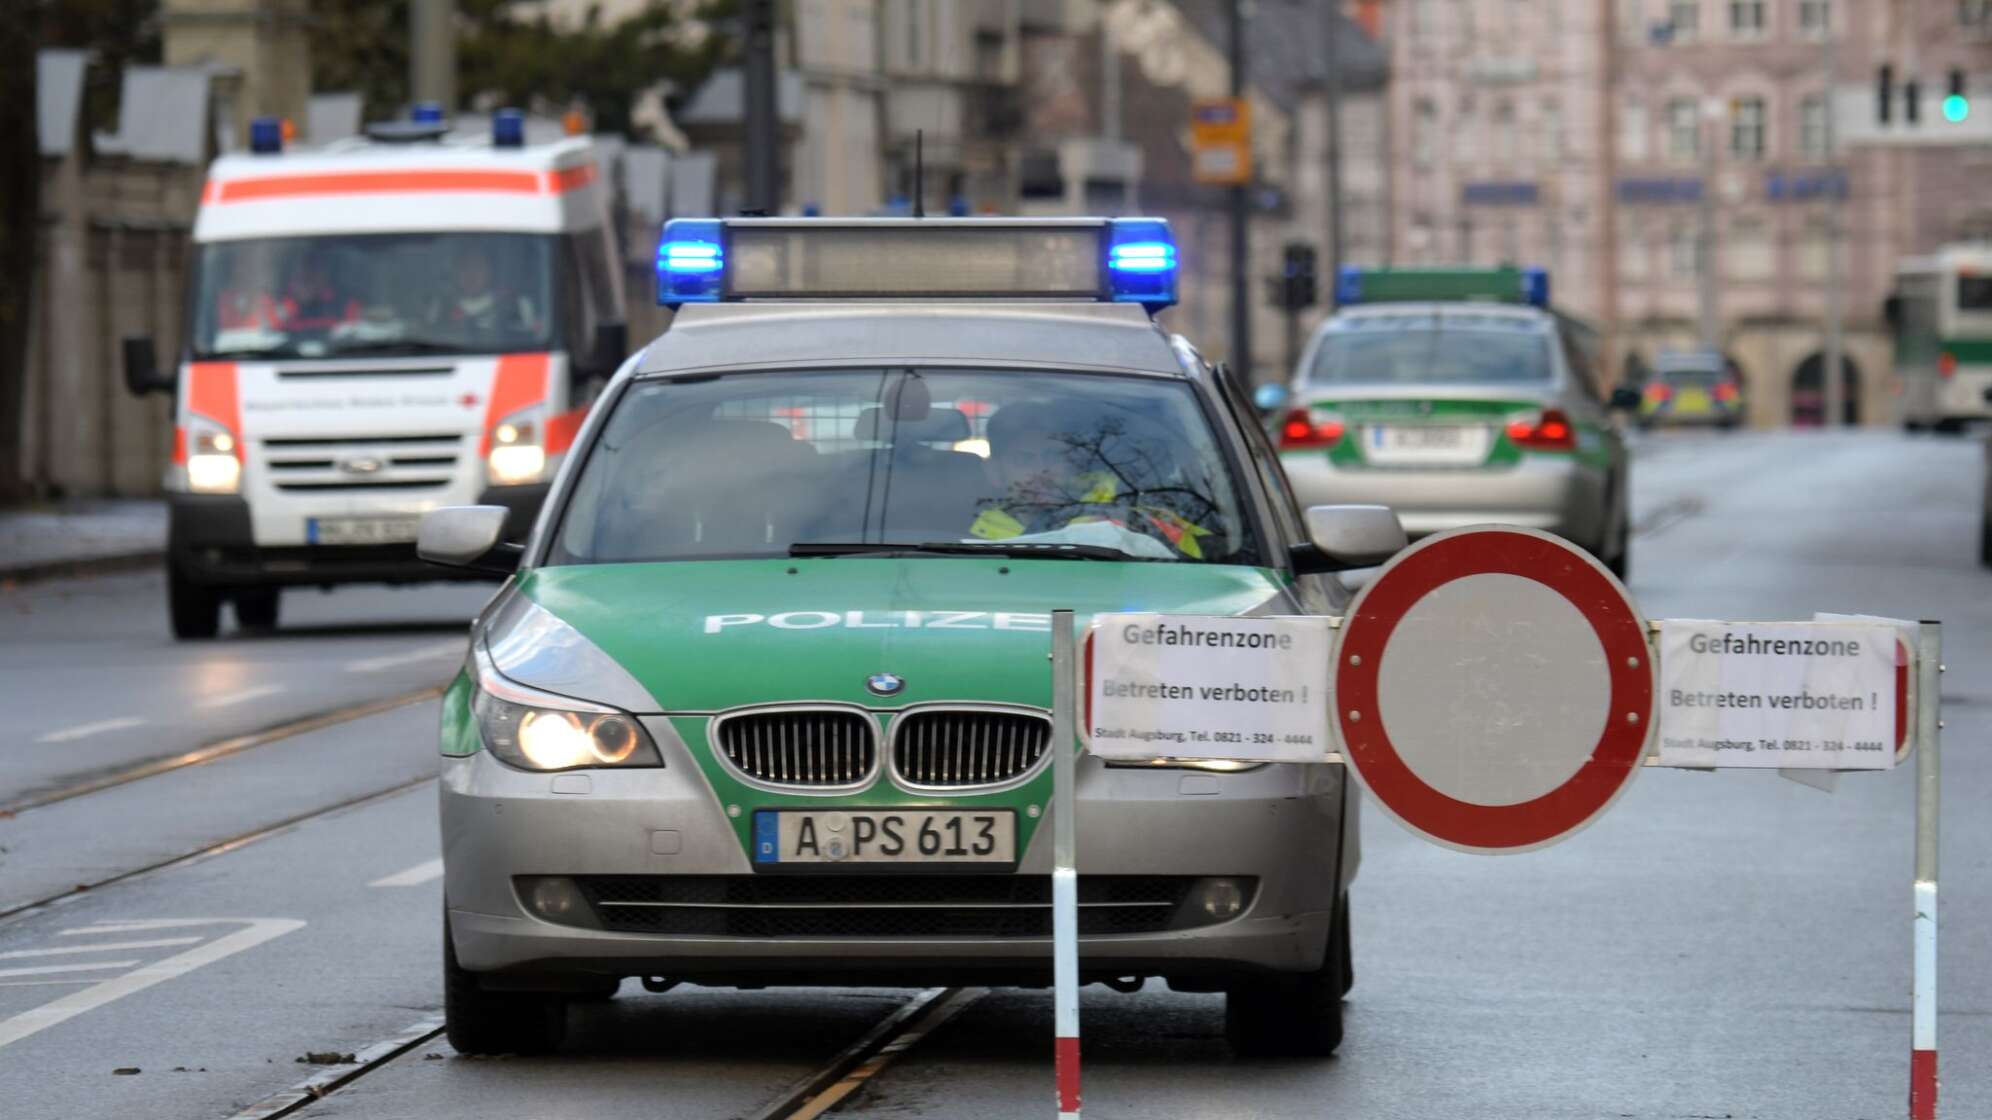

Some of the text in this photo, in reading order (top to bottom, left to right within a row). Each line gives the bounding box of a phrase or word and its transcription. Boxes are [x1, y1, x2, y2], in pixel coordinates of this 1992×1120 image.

[704, 611, 1052, 633] POLIZE
[1123, 624, 1292, 649] Gefahrenzone
[1690, 633, 1860, 656] Gefahrenzone
[1103, 679, 1193, 700] Betreten
[1200, 683, 1294, 703] verboten
[1670, 689, 1762, 709] Betreten
[1768, 691, 1863, 710] verboten
[1095, 728, 1125, 739] Stadt
[1189, 730, 1210, 742] Tel.
[1214, 732, 1242, 743] 0821
[1252, 733, 1274, 744] 324
[1759, 739, 1780, 750] Tel.
[796, 816, 820, 856] A
[852, 816, 905, 856] PS
[918, 816, 995, 856] 613
